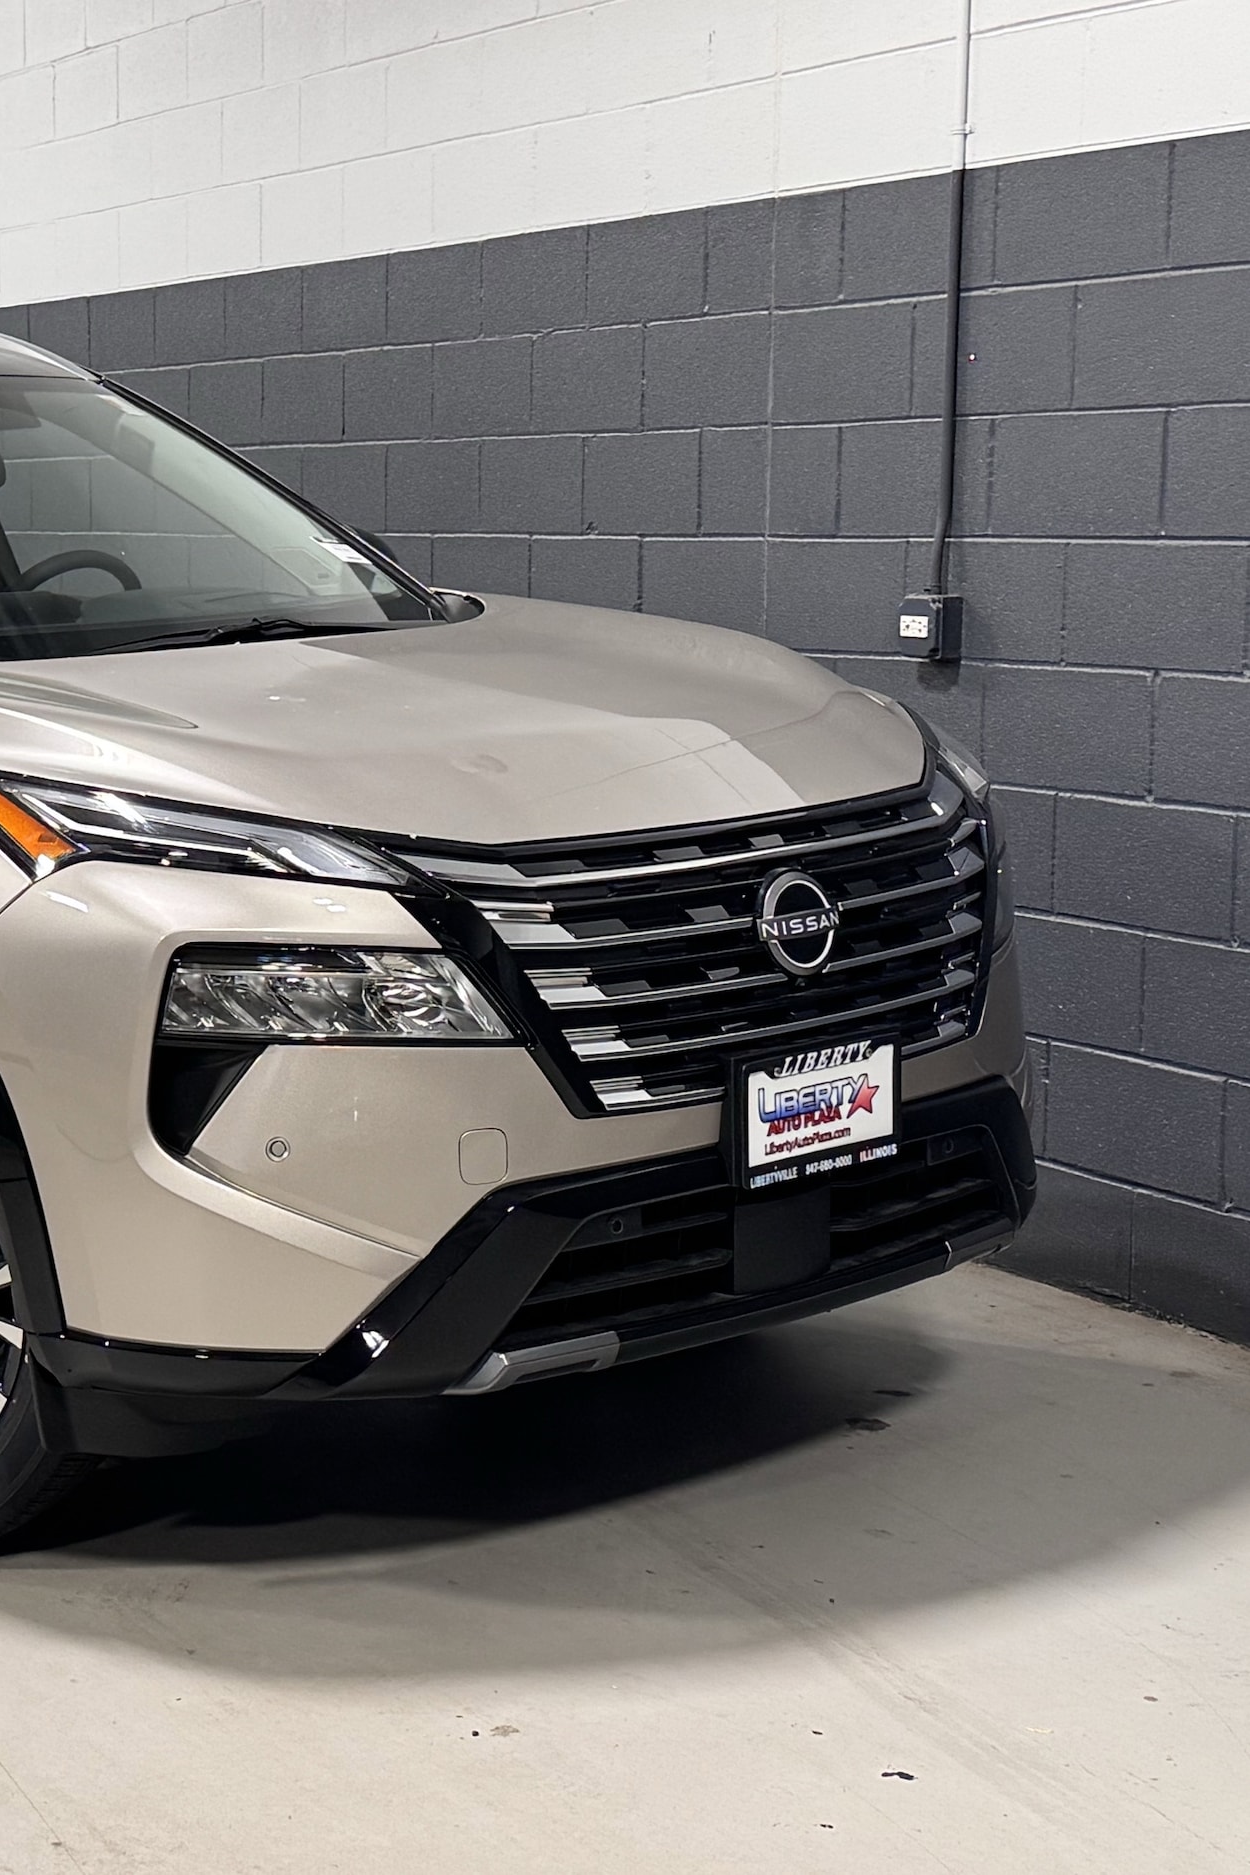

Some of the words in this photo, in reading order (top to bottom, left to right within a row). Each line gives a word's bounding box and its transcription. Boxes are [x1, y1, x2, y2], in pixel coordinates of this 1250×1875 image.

[762, 911, 840, 938] NISSAN
[774, 1040, 873, 1078] LIBERTY
[758, 1073, 868, 1123] LIBERTY
[767, 1113, 803, 1137] AUTO
[803, 1104, 842, 1129] PLAZA
[750, 1166, 798, 1189] LIBERTYVILLE
[859, 1143, 898, 1163] ILLINOIS
